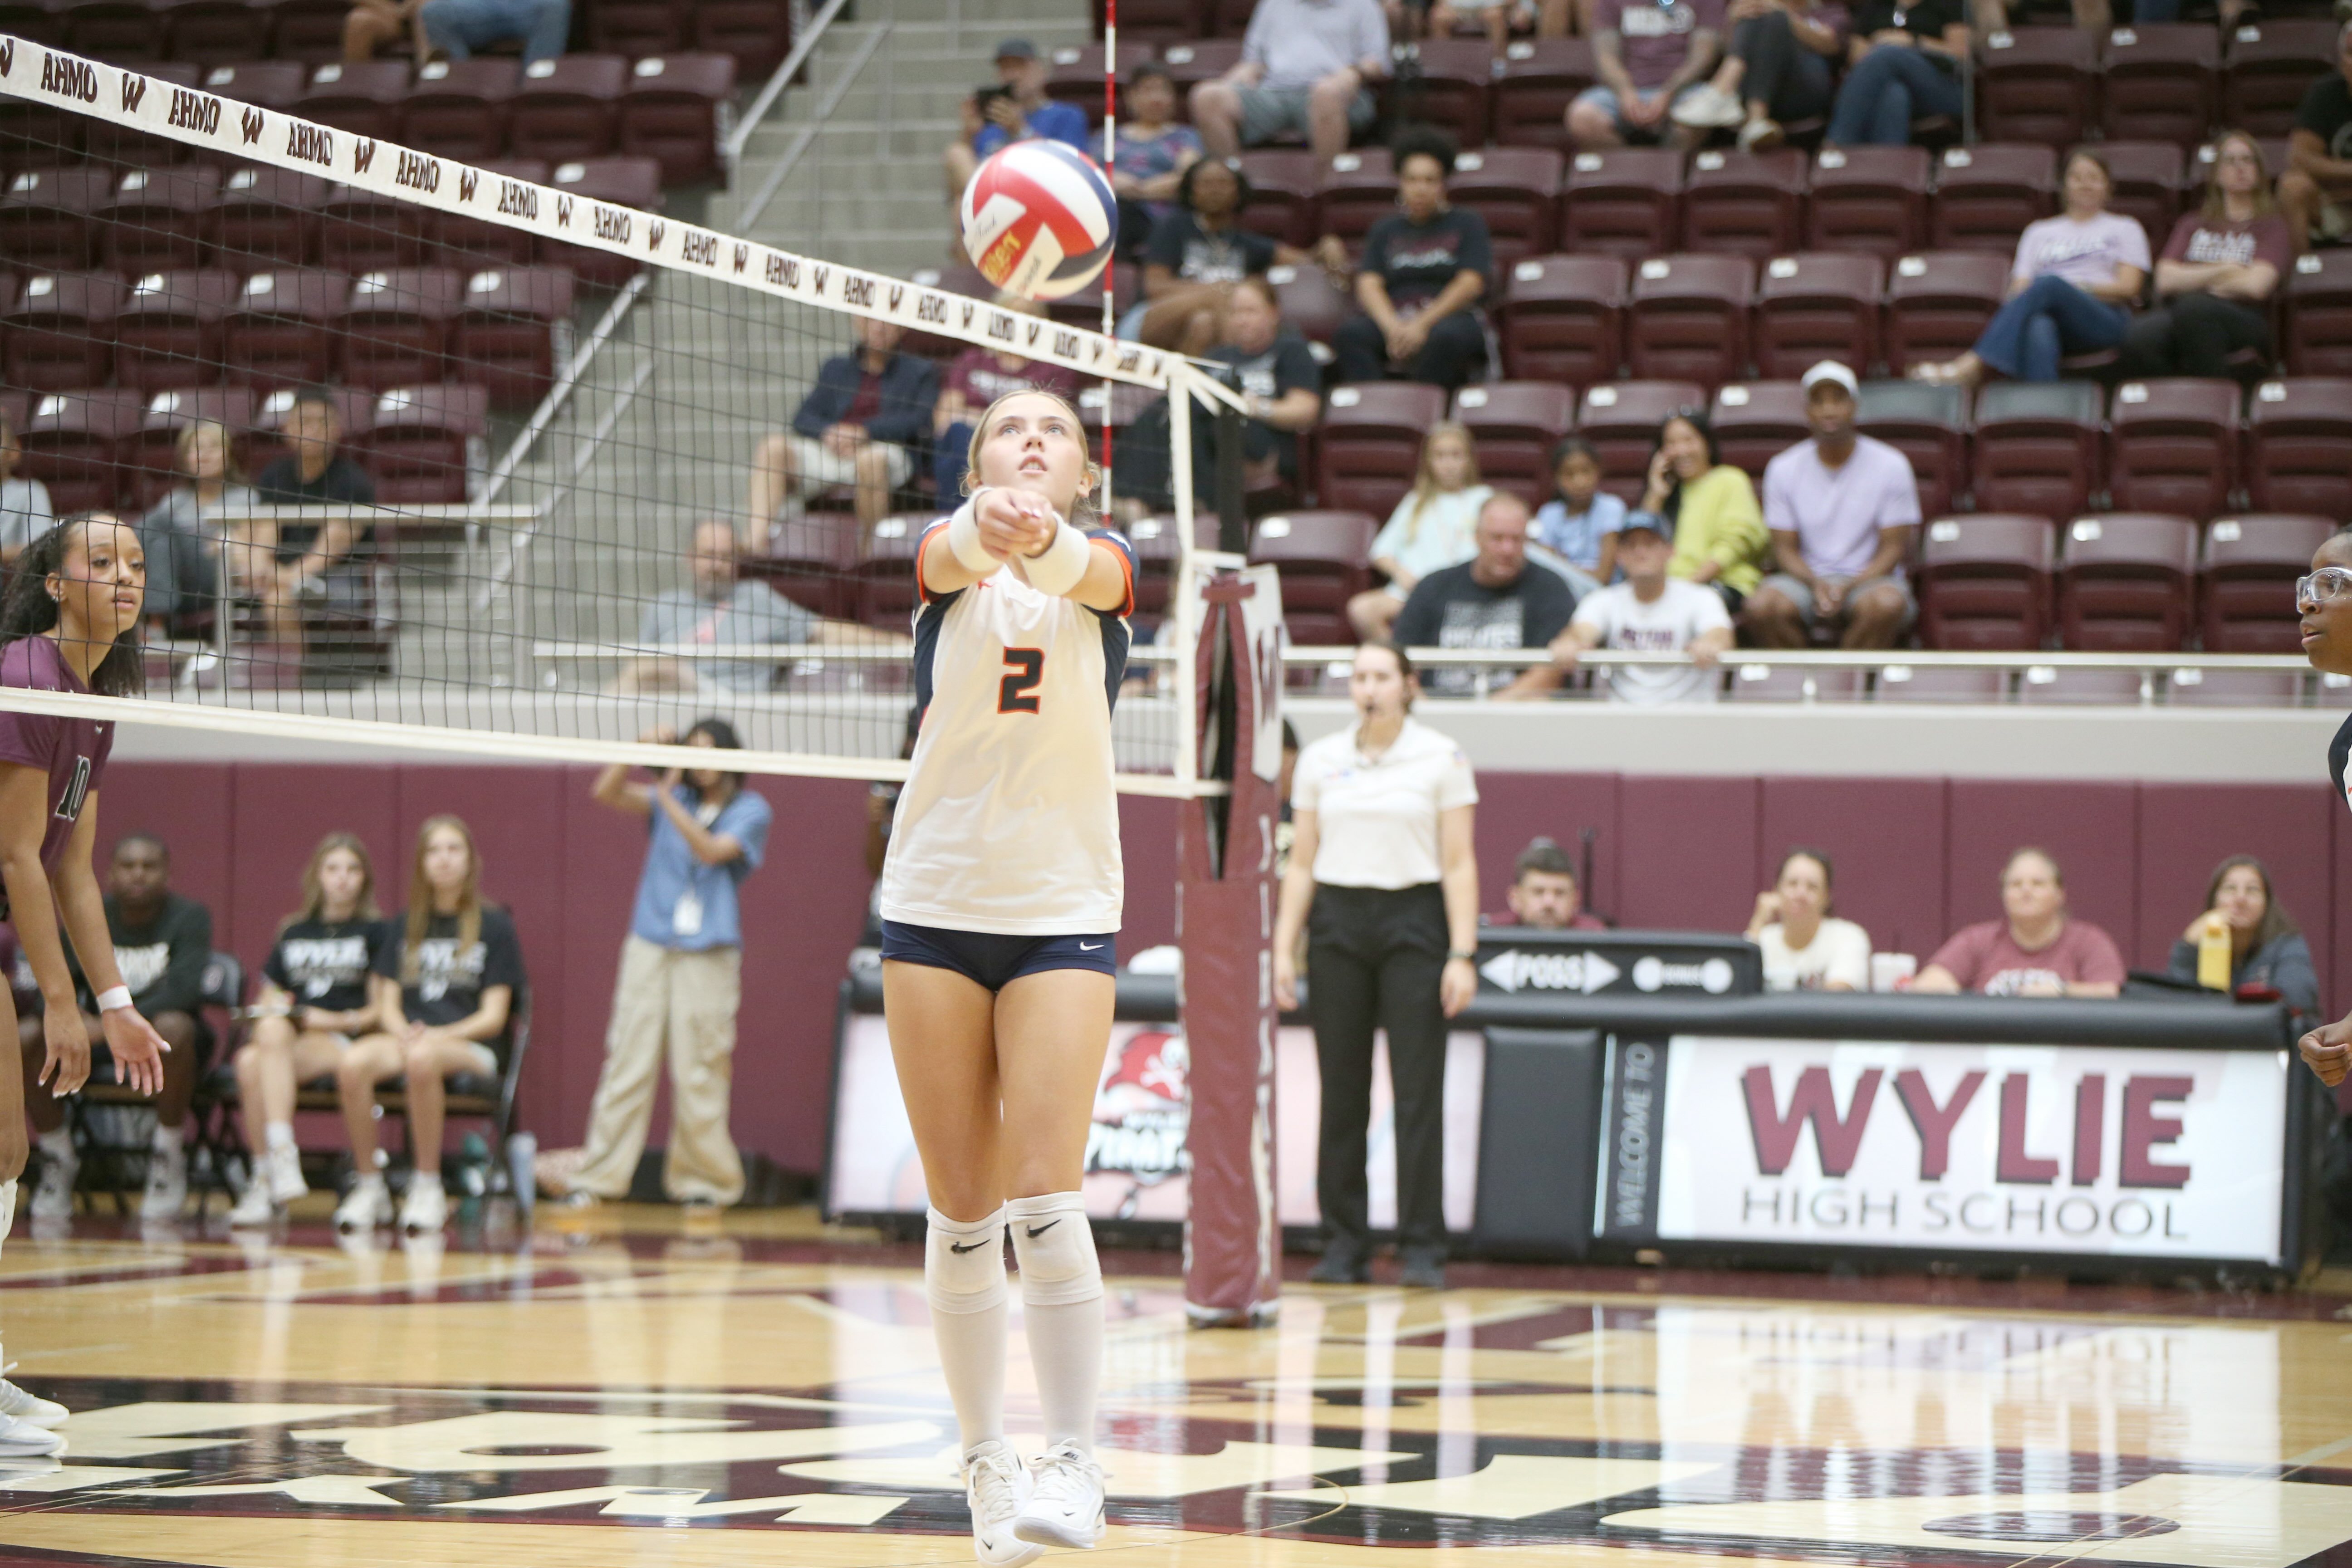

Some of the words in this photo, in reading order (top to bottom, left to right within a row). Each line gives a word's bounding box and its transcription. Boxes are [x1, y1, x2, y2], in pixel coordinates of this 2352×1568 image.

[41, 52, 97, 103] AHMO
[122, 73, 146, 113] W
[168, 89, 221, 135] AHMO
[241, 107, 264, 145] W
[287, 122, 332, 166] AHMO
[355, 137, 376, 174] W
[396, 151, 440, 193] AHMO
[460, 169, 477, 201] W
[498, 181, 536, 220] AHMO
[558, 196, 571, 225] W
[595, 207, 630, 244] AHMO
[650, 223, 664, 250] W
[734, 245, 746, 272] W
[998, 646, 1044, 714] 2
[55, 754, 91, 822] 10
[1516, 954, 1583, 990] POSS
[1624, 1042, 1655, 1083] TO
[1615, 1087, 1652, 1227] WELCOME
[1741, 1063, 2195, 1189] WYLIE
[1741, 1187, 1898, 1230] HIGH
[1922, 1191, 2188, 1240] SCHOOL
